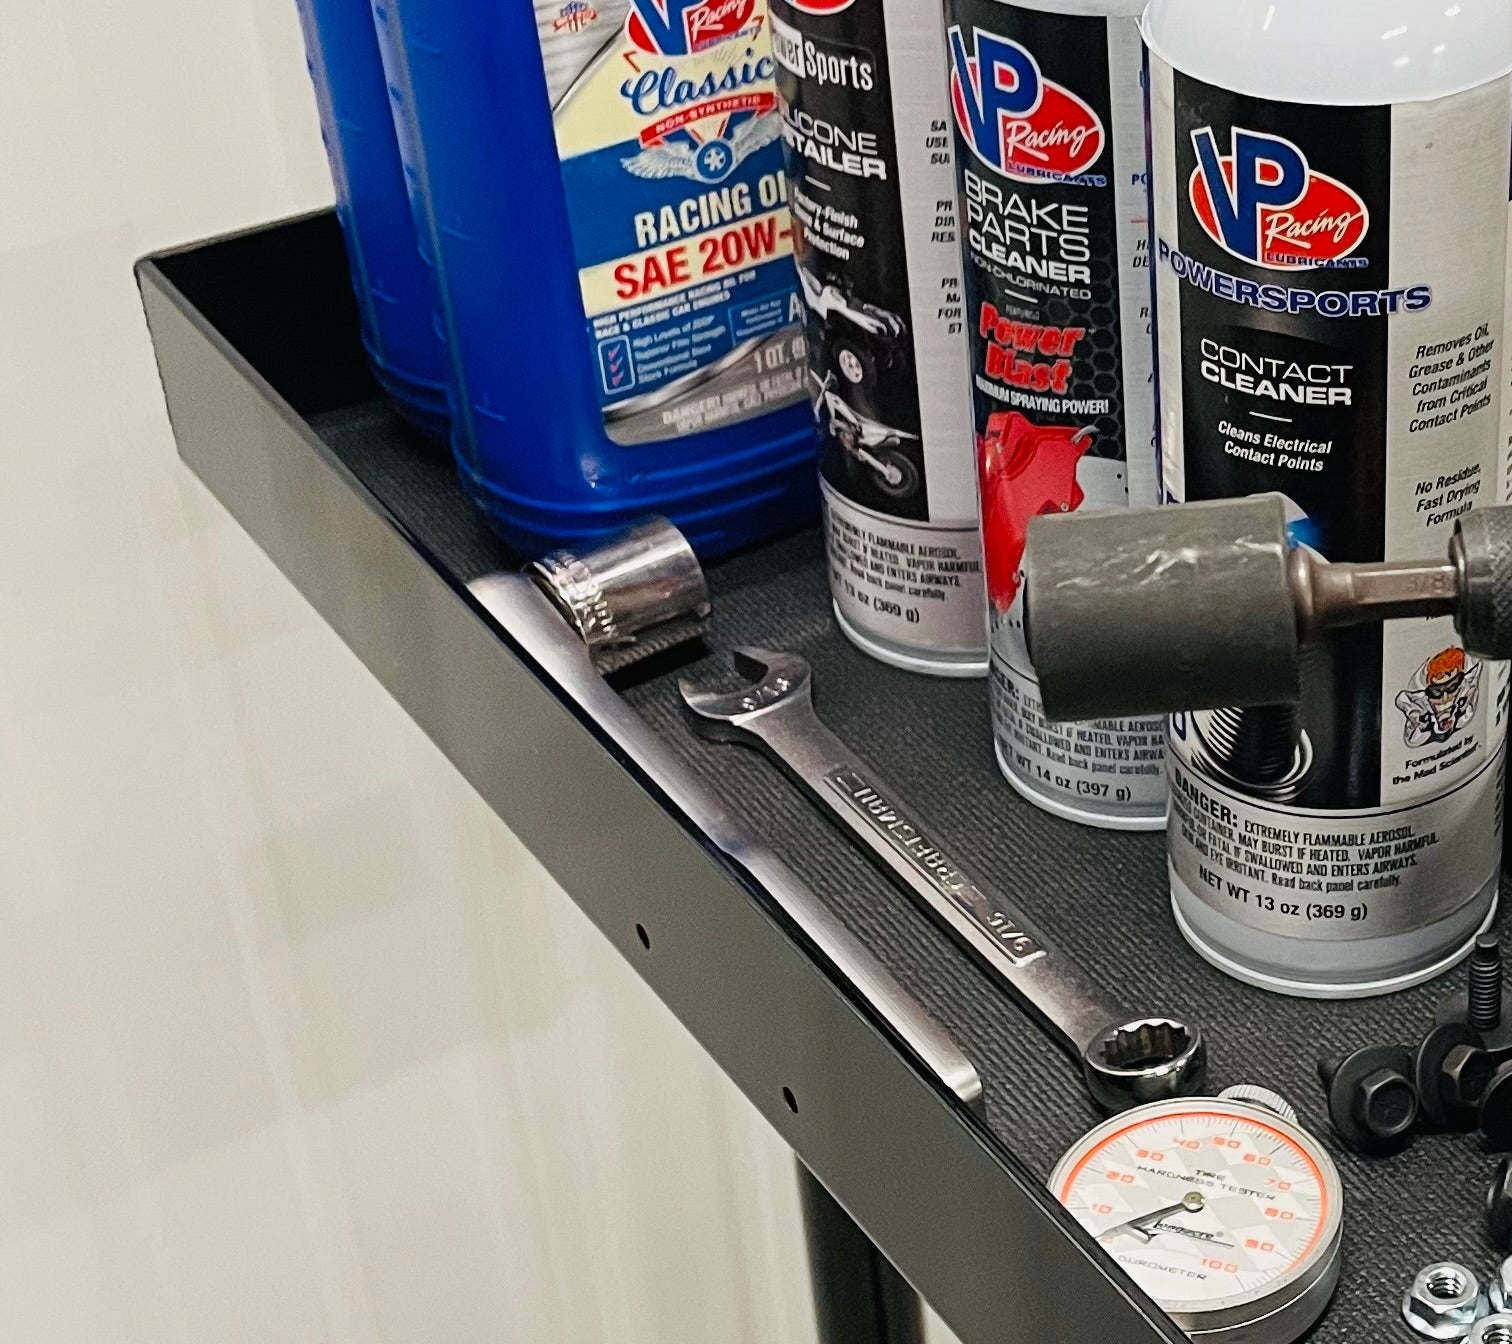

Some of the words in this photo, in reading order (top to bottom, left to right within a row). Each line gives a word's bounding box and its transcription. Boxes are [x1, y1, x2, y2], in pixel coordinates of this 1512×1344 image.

[621, 48, 775, 116] Classic
[805, 39, 874, 91] Sports
[947, 25, 1044, 174] VP
[1006, 120, 1099, 161] Racing
[1008, 161, 1107, 187] LUBRICANTS
[634, 183, 751, 248] RACING
[759, 170, 788, 206] OI
[964, 169, 1089, 234] BRAKE
[1190, 126, 1309, 264] VP
[967, 198, 1091, 262] PARTS
[1265, 210, 1365, 250] Racing
[614, 246, 691, 299] SAE
[700, 217, 793, 275] 20W-
[969, 228, 1091, 284] CLEANER
[1265, 251, 1369, 270] LUBRICANTS
[1158, 238, 1433, 317] POWERSPORTS
[979, 302, 1087, 356] Power
[1416, 332, 1472, 359] Removes
[1201, 337, 1353, 384] CONTACT
[1409, 358, 1454, 378] Grease
[1456, 352, 1465, 366] &
[1468, 339, 1494, 361] Other
[1201, 360, 1352, 405] CLEANER
[1412, 359, 1491, 396] Contaminants
[1416, 396, 1447, 413] from
[1450, 376, 1488, 404] Critical
[1011, 391, 1060, 413] SPRAYING
[1062, 399, 1109, 414] POWER!
[1409, 408, 1458, 432] Contact
[1460, 394, 1491, 418] Points
[1218, 420, 1261, 445] Cleans
[1264, 433, 1333, 454] Electrical
[1225, 440, 1274, 466] Contact
[1278, 455, 1324, 472] Points
[1415, 481, 1432, 496] No
[1416, 494, 1443, 512] Fast
[1447, 479, 1481, 503] Drying
[1426, 501, 1472, 527] Formula
[1405, 740, 1462, 769] Formulated
[1036, 766, 1051, 781] 14
[1055, 776, 1072, 789] oz
[1076, 780, 1109, 796] (397
[1116, 786, 1132, 802] g)
[1392, 775, 1411, 785] the
[1414, 765, 1437, 779] Mad
[1175, 768, 1238, 828] DANGER:
[1244, 819, 1300, 844] EXTREMELY
[1304, 833, 1366, 847] FLAMMABLE
[1369, 825, 1416, 845] AEROSOL
[854, 787, 965, 891] CRAFTSMAN
[1238, 832, 1259, 849] MAY
[1262, 841, 1293, 858] BURST
[1297, 847, 1306, 859] IF
[1310, 849, 1351, 862] HEATED.
[1358, 845, 1392, 861] VAPOR
[1394, 832, 1440, 855] HARMFUL
[1244, 849, 1303, 874] SWALLOWED
[1306, 863, 1328, 877] AND
[1331, 863, 1370, 877] ENTERS
[1372, 853, 1418, 875] AIRWAYS
[1200, 864, 1223, 890] NET
[1226, 882, 1250, 903] WT
[1256, 894, 1275, 911] 13
[1280, 903, 1300, 916] oz
[1306, 903, 1346, 920] (369
[1350, 903, 1368, 921] g)
[1272, 872, 1296, 888] Read
[1299, 878, 1323, 892] back
[1326, 878, 1353, 893] panel
[1136, 1148, 1164, 1161] 30
[1172, 1137, 1201, 1151] 40
[1212, 1136, 1241, 1150] 50
[1243, 1153, 1271, 1167] 60
[1106, 1171, 1135, 1184] 20
[1137, 1165, 1215, 1188] HARDNESS
[1220, 1183, 1276, 1201] TESTER
[1195, 1169, 1226, 1181] TIRE
[1265, 1178, 1291, 1191] 70
[1092, 1203, 1113, 1215] 10
[1118, 1255, 1207, 1281] DUROMETER
[1202, 1258, 1239, 1273] 100
